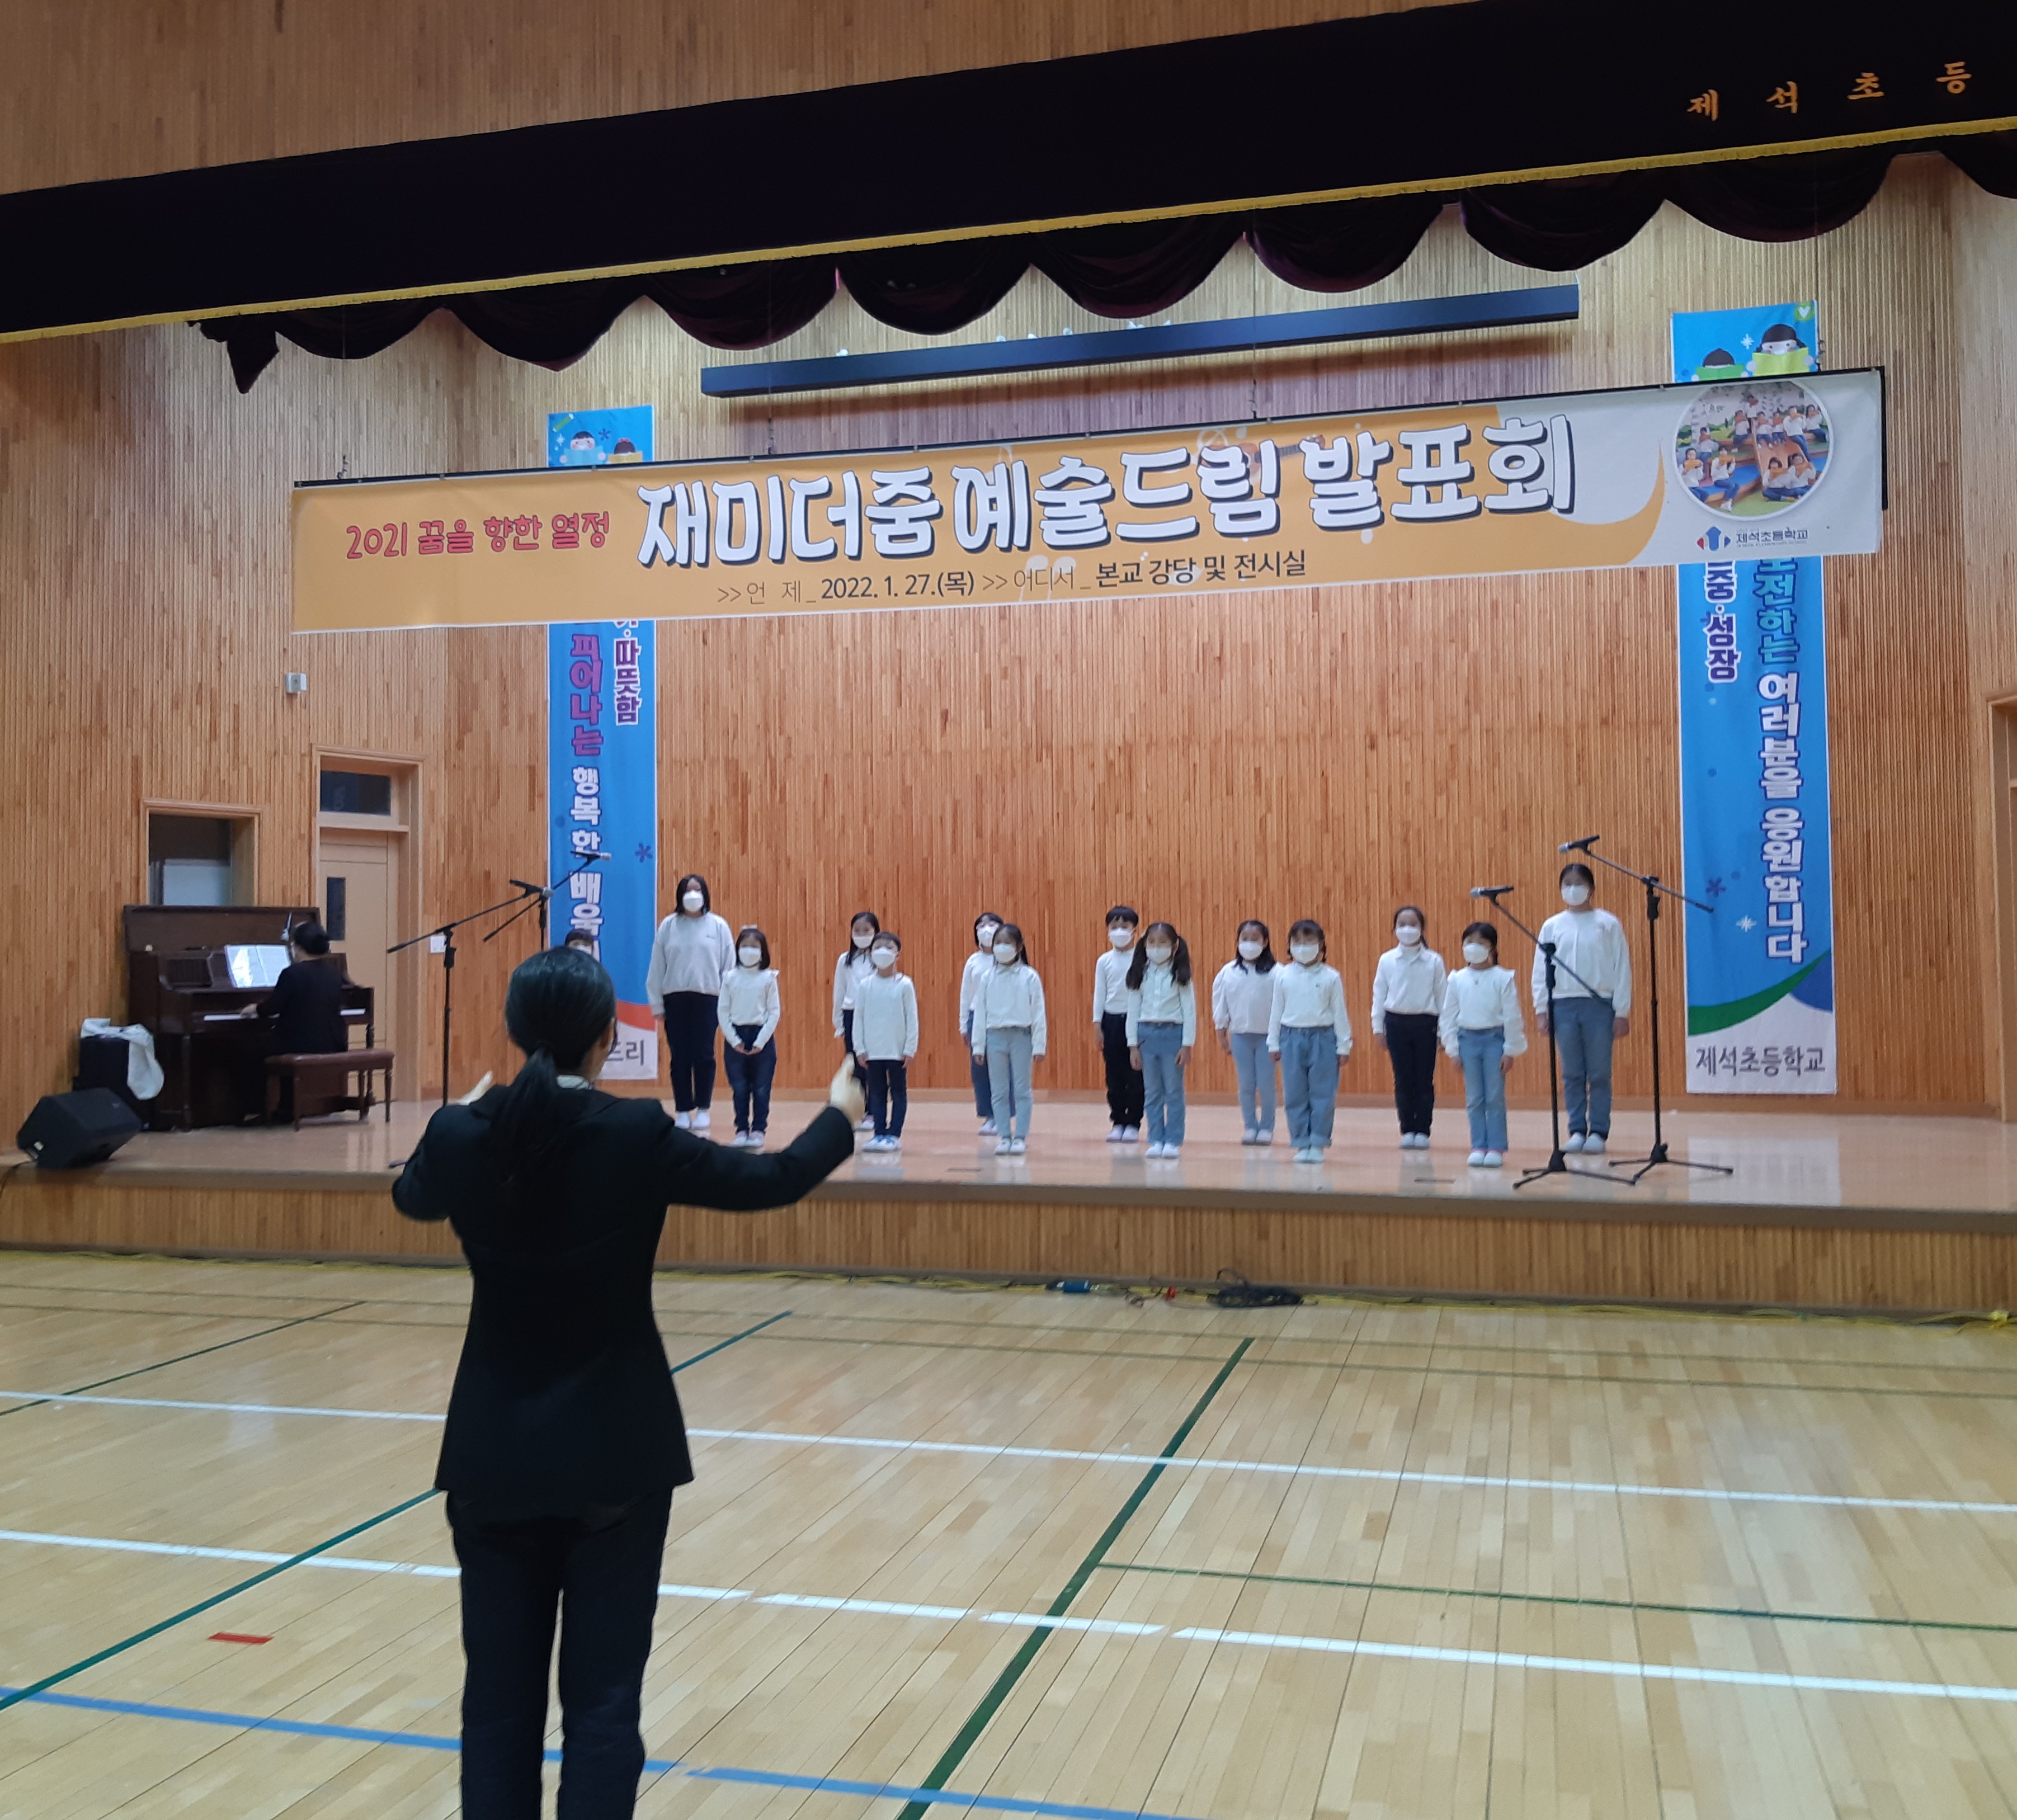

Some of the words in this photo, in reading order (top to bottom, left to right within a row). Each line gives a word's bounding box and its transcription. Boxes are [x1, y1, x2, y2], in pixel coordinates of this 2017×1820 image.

[1301, 414, 1575, 531] 발표회
[346, 521, 407, 559] 2021
[417, 519, 475, 555] 꿈을
[483, 514, 543, 553] 향한
[552, 511, 610, 549] 열정
[1203, 554, 1227, 582] 및
[1233, 549, 1307, 580] 전시실
[1736, 527, 1808, 543] 제석초등학교
[569, 634, 604, 756] 피어나는
[1757, 671, 1803, 800] 여러분을
[568, 870, 604, 963] 배움
[1760, 807, 1809, 964] 응원합니다
[1695, 1045, 1826, 1077] 제석초등학교
